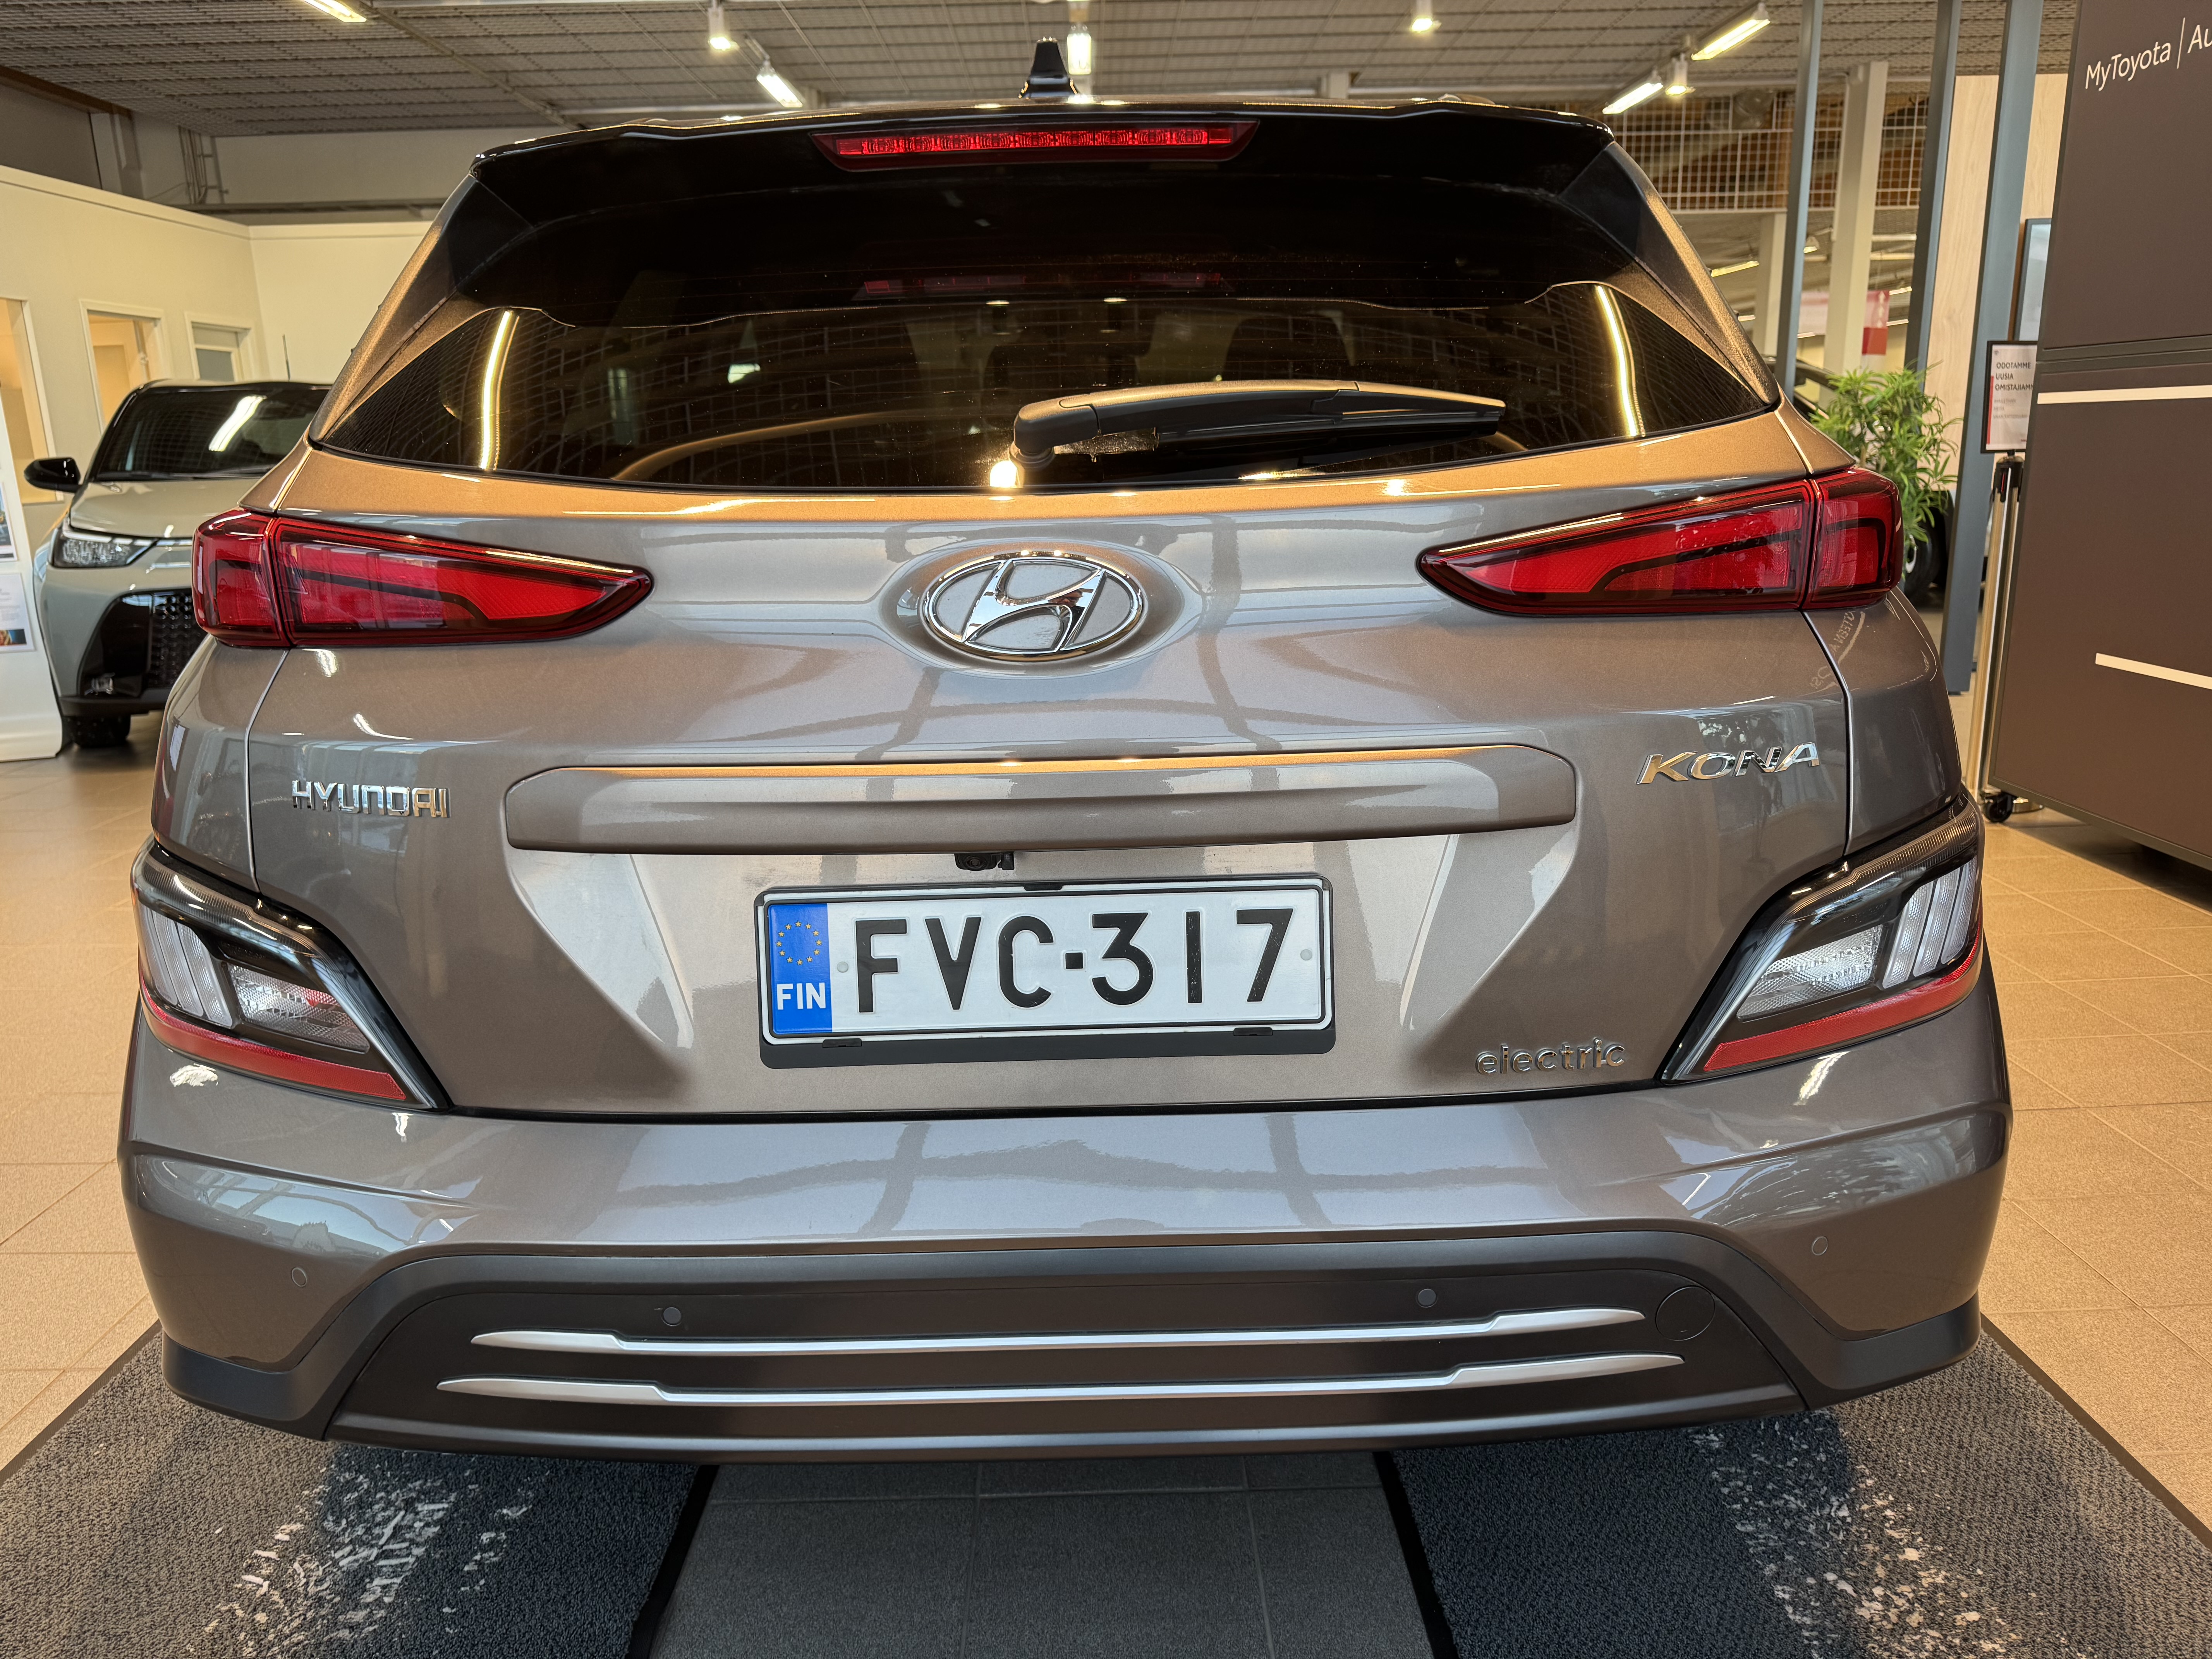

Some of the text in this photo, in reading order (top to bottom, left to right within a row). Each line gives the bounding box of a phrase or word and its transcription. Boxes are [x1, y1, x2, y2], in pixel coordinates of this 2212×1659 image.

[2085, 41, 2171, 91] MyToyota
[1635, 742, 1820, 785] KONA
[292, 779, 451, 818] HYUNDAI
[777, 983, 826, 1010] FIN
[1475, 1037, 1625, 1075] electric
